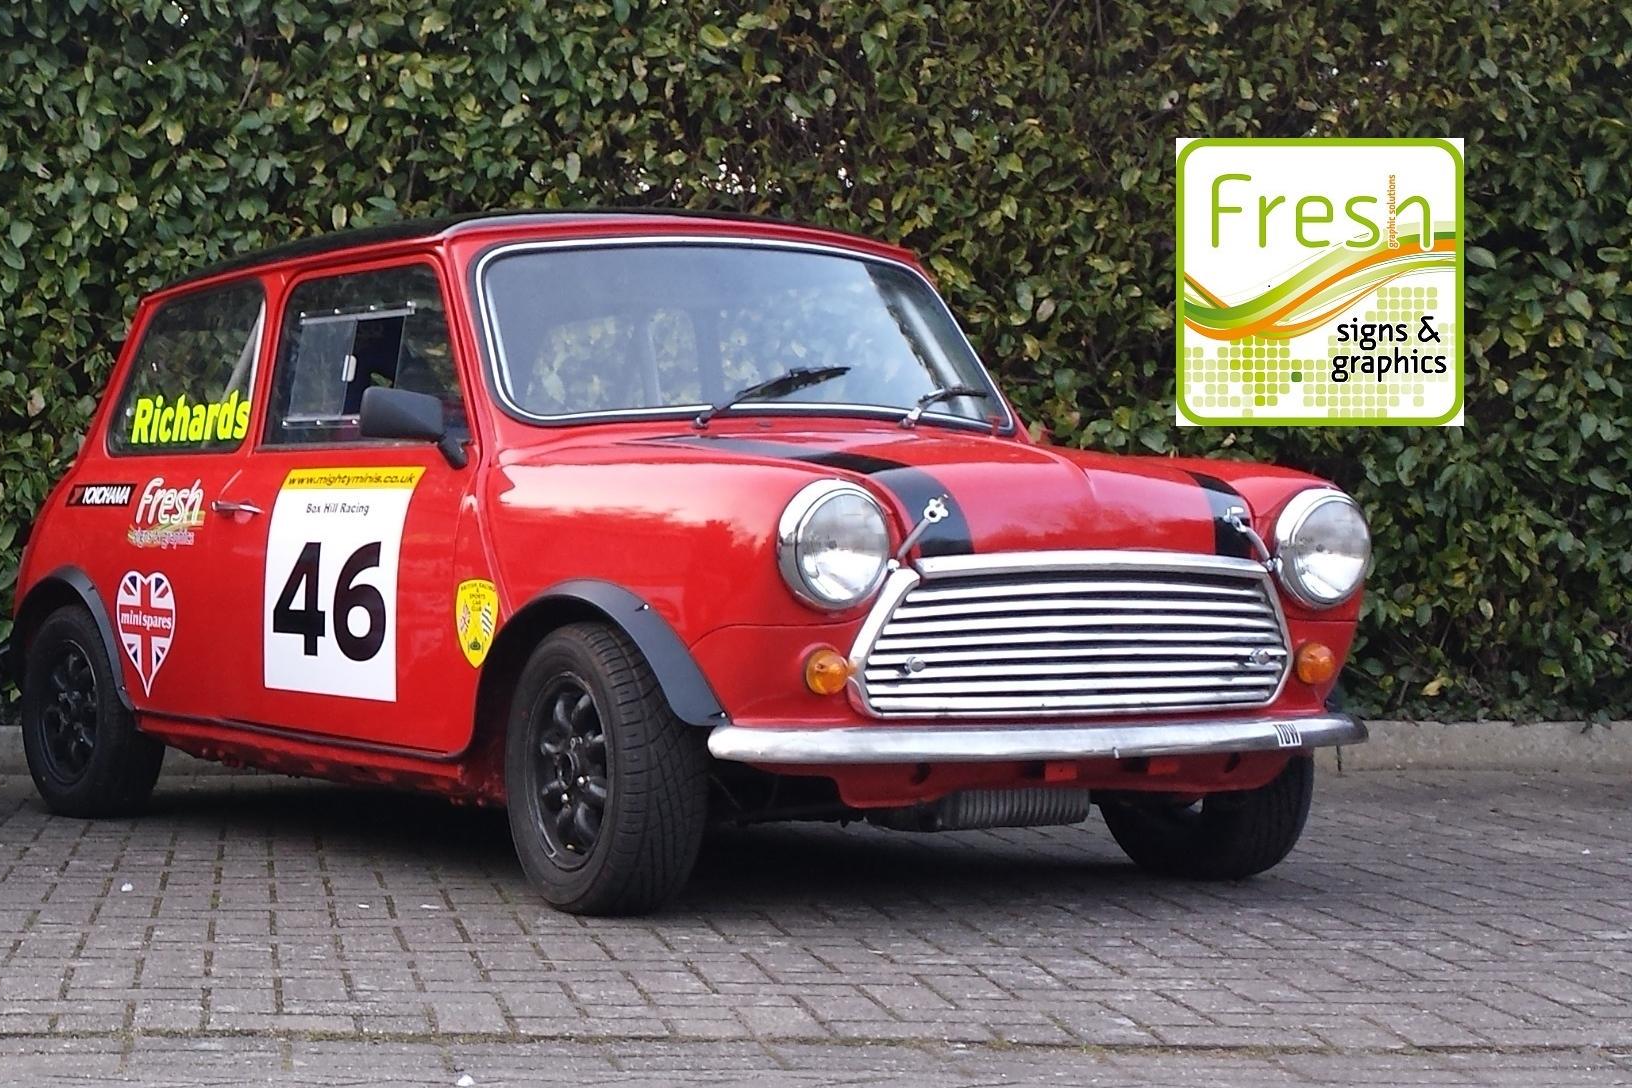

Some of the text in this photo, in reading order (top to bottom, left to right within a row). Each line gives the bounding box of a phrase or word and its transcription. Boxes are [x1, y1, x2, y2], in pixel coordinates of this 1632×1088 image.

[131, 390, 251, 444] Richards
[82, 486, 131, 505] YOKOHAMA
[288, 473, 414, 486] www.mightyminis.co.uk
[135, 477, 204, 525] Fresh
[324, 503, 338, 514] Hill
[340, 503, 370, 516] Racing
[273, 541, 386, 662] 46
